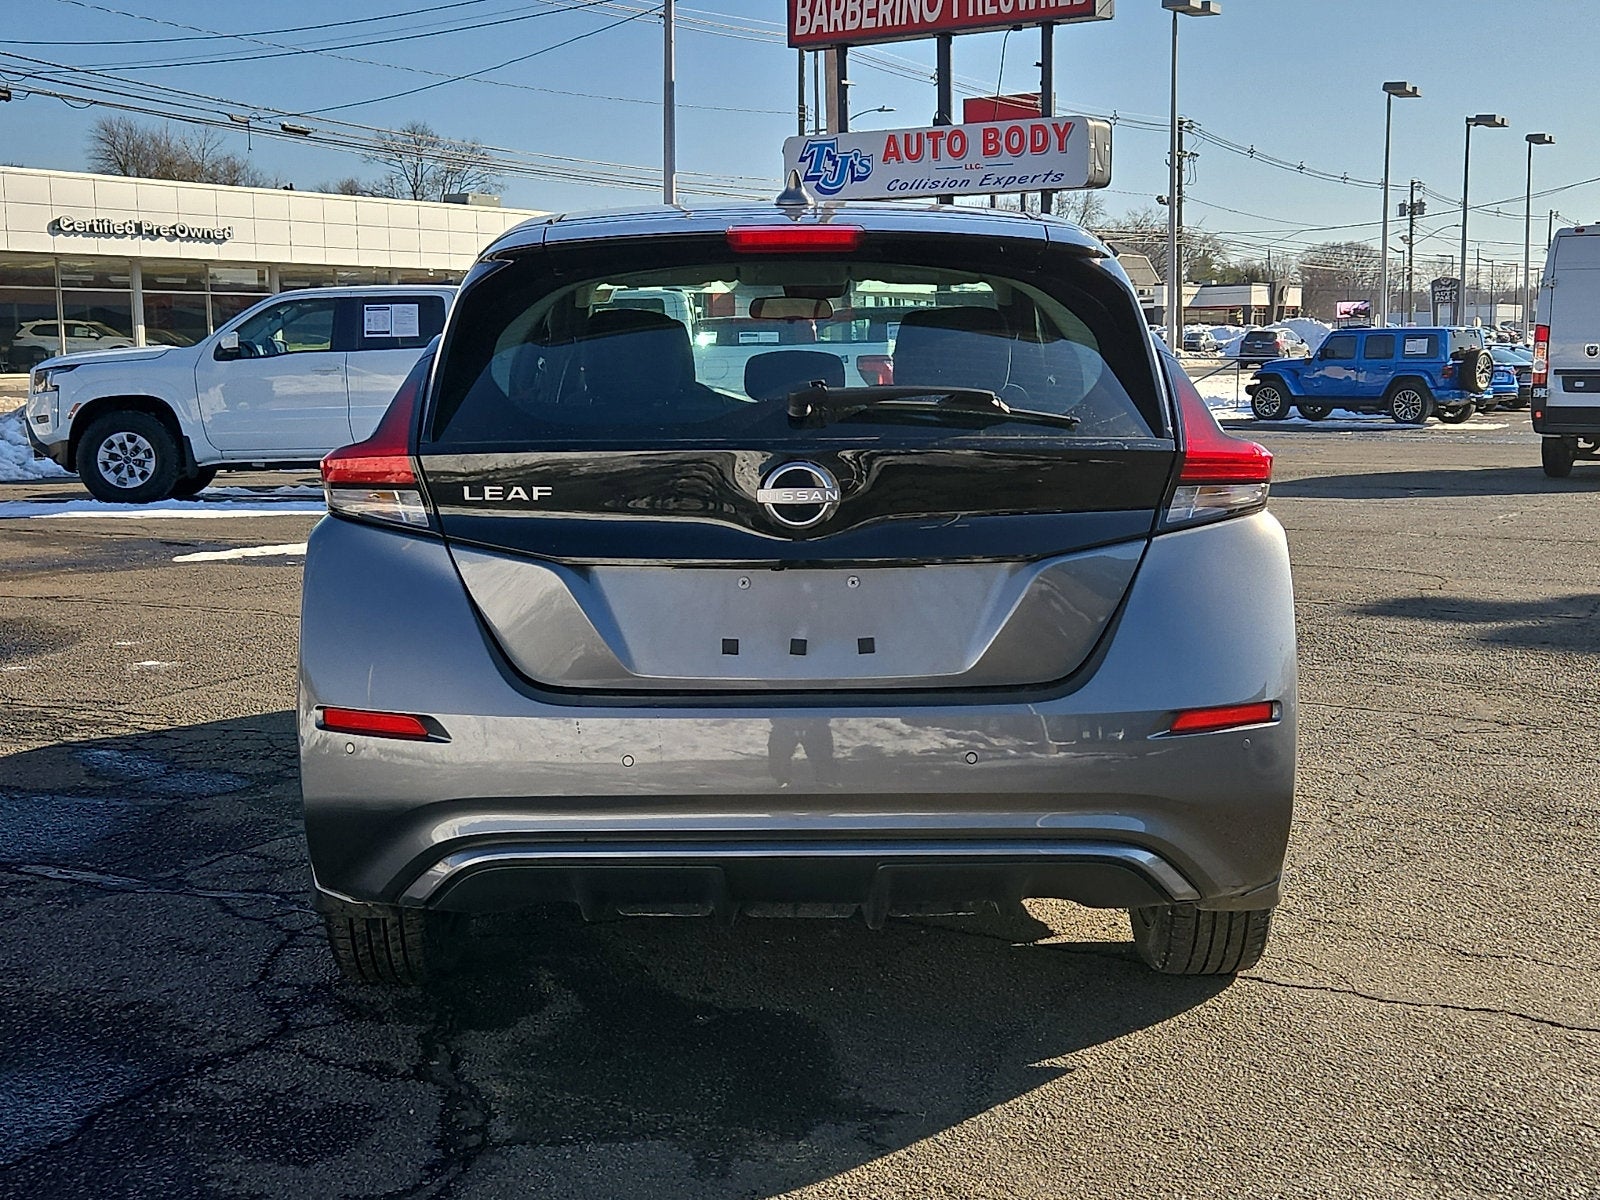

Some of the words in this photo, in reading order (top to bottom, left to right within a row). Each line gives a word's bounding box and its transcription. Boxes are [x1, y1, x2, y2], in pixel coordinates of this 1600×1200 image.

[882, 129, 968, 164] AUTO
[982, 122, 1074, 158] BODY
[799, 138, 873, 195] TJ's
[886, 176, 970, 192] Collision
[979, 170, 1065, 188] Experts
[59, 215, 136, 236] Certified
[141, 220, 234, 240] Pre-Owned
[463, 486, 553, 501] LEAF
[760, 490, 838, 501] NISSAN
